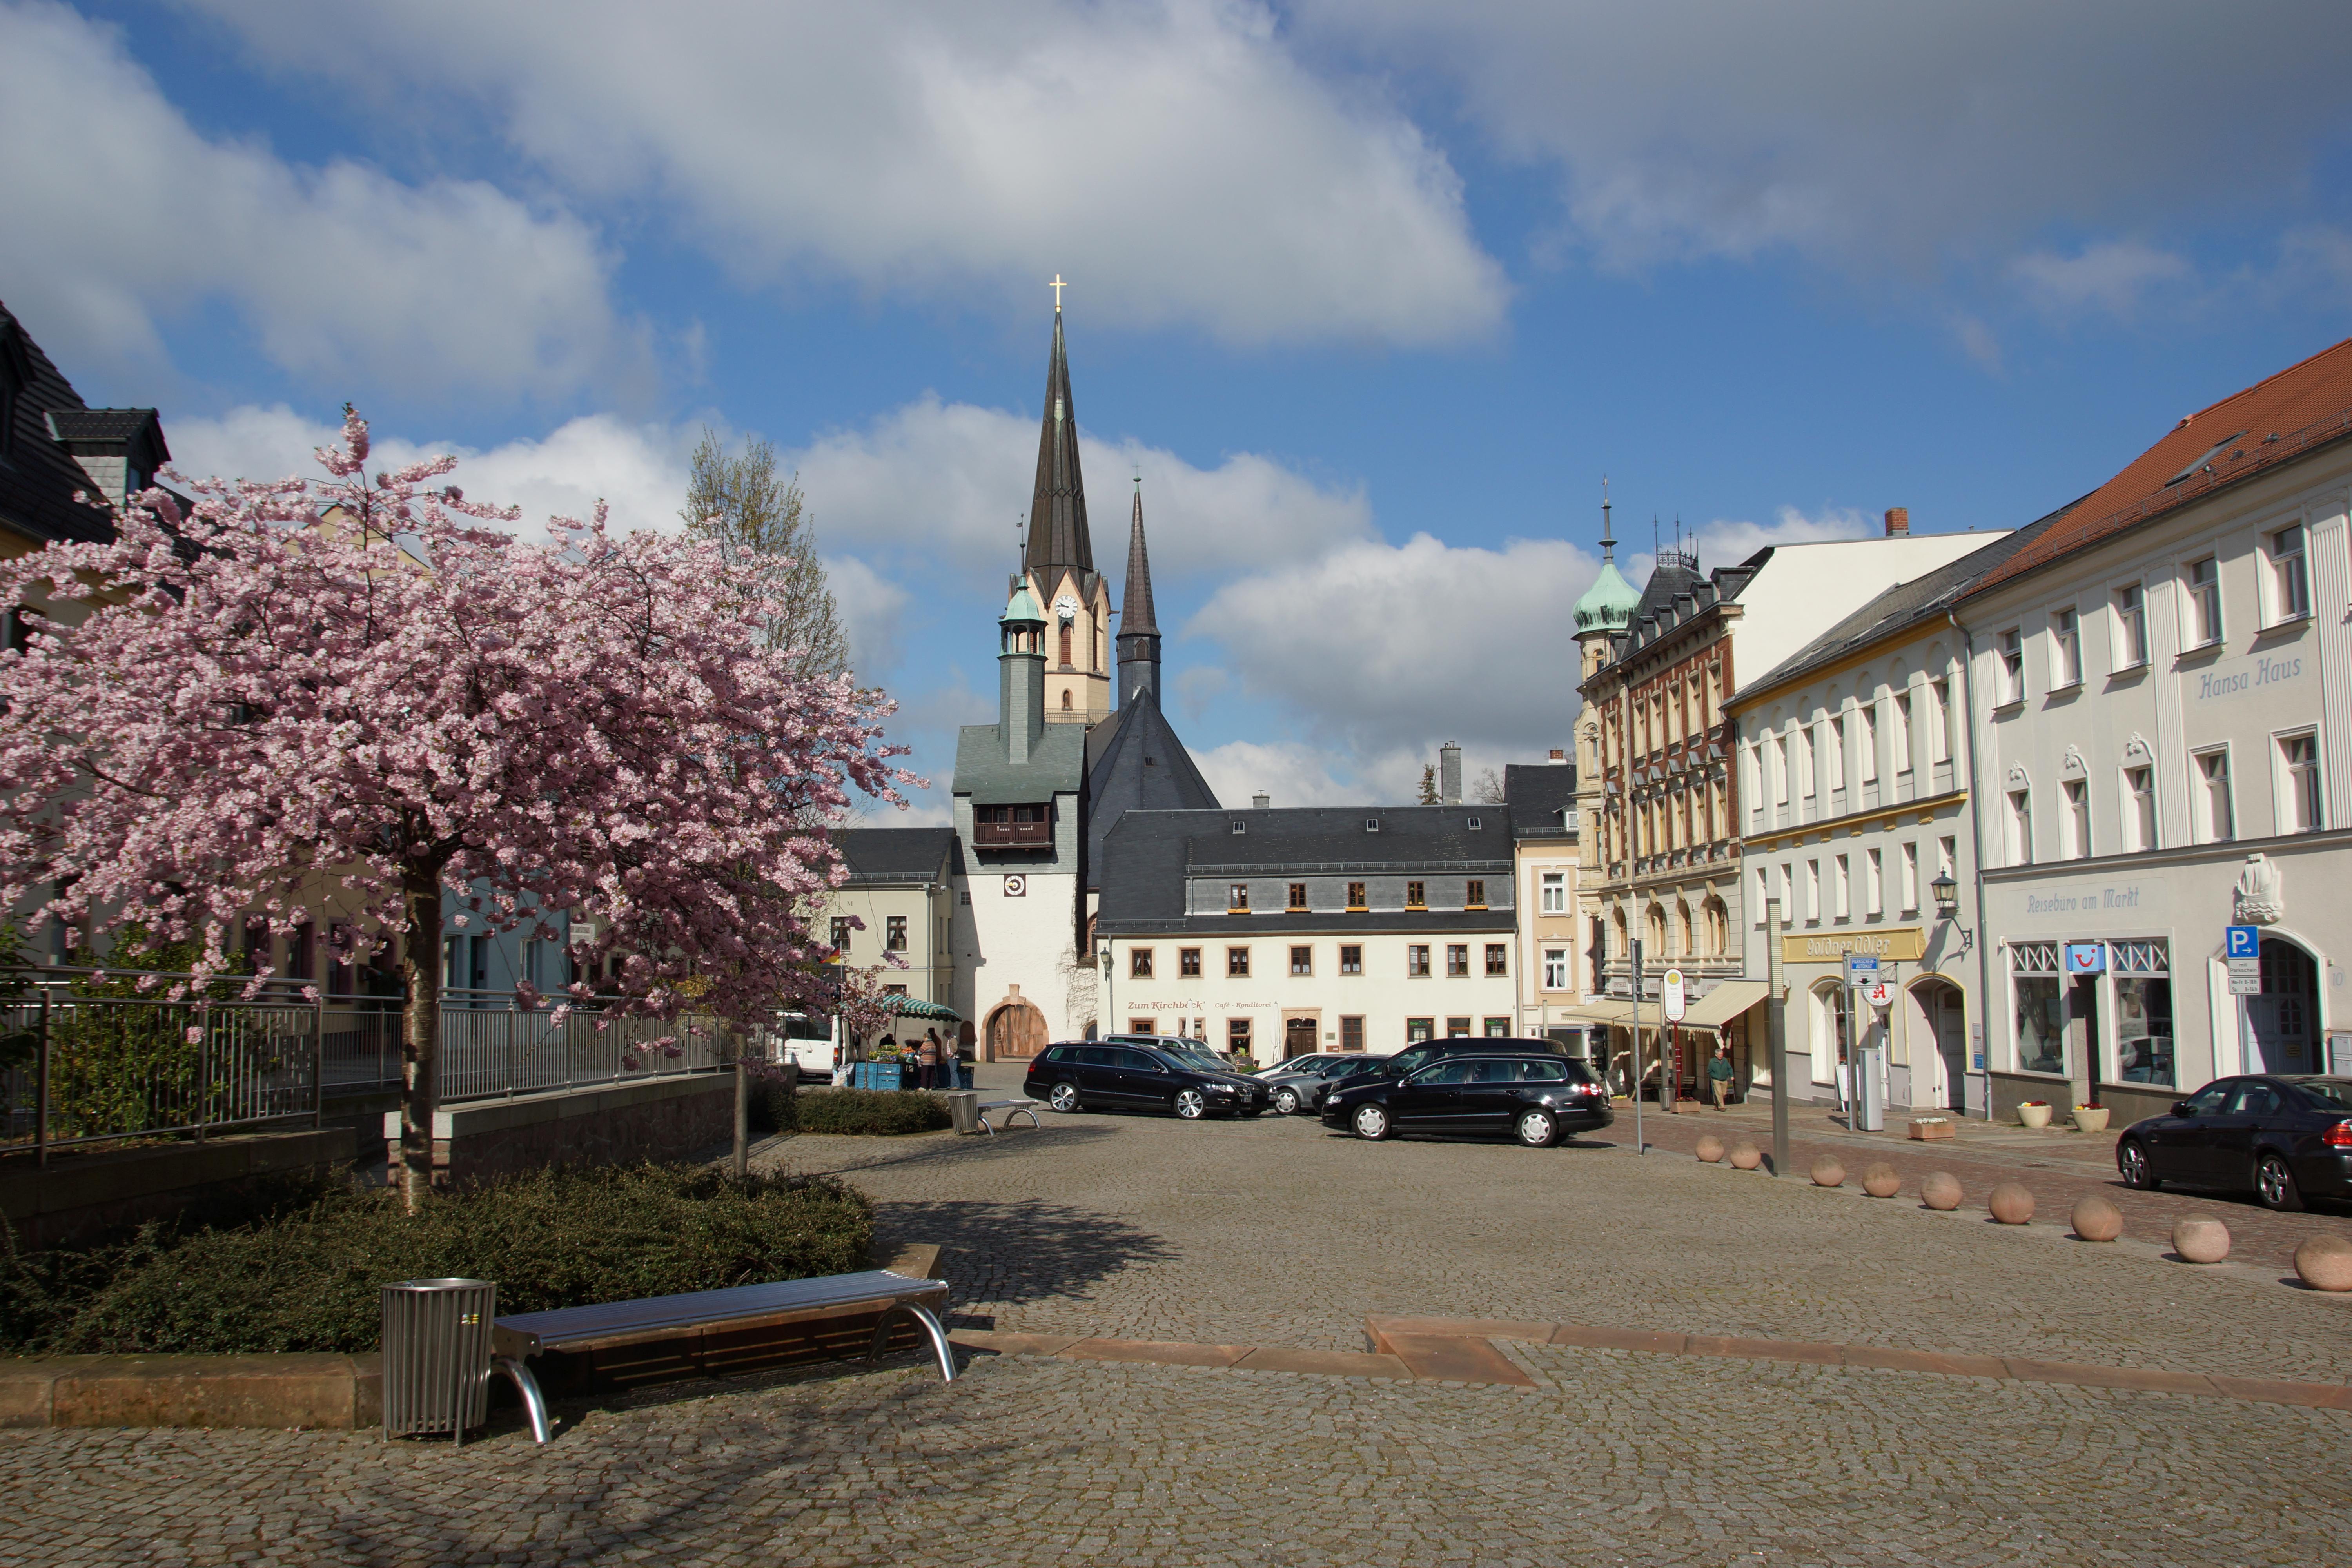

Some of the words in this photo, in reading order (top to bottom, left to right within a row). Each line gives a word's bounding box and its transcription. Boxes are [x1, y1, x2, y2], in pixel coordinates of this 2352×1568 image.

[2199, 673, 2249, 699] Hansa
[2255, 657, 2301, 686] Haus
[2027, 893, 2076, 913] Reisebüro
[2082, 896, 2097, 909] am
[2103, 886, 2140, 908] Markt
[1807, 938, 1852, 956] Goldner
[1855, 935, 1891, 955] Adler
[2231, 931, 2249, 953] P
[2332, 972, 2343, 986] 10
